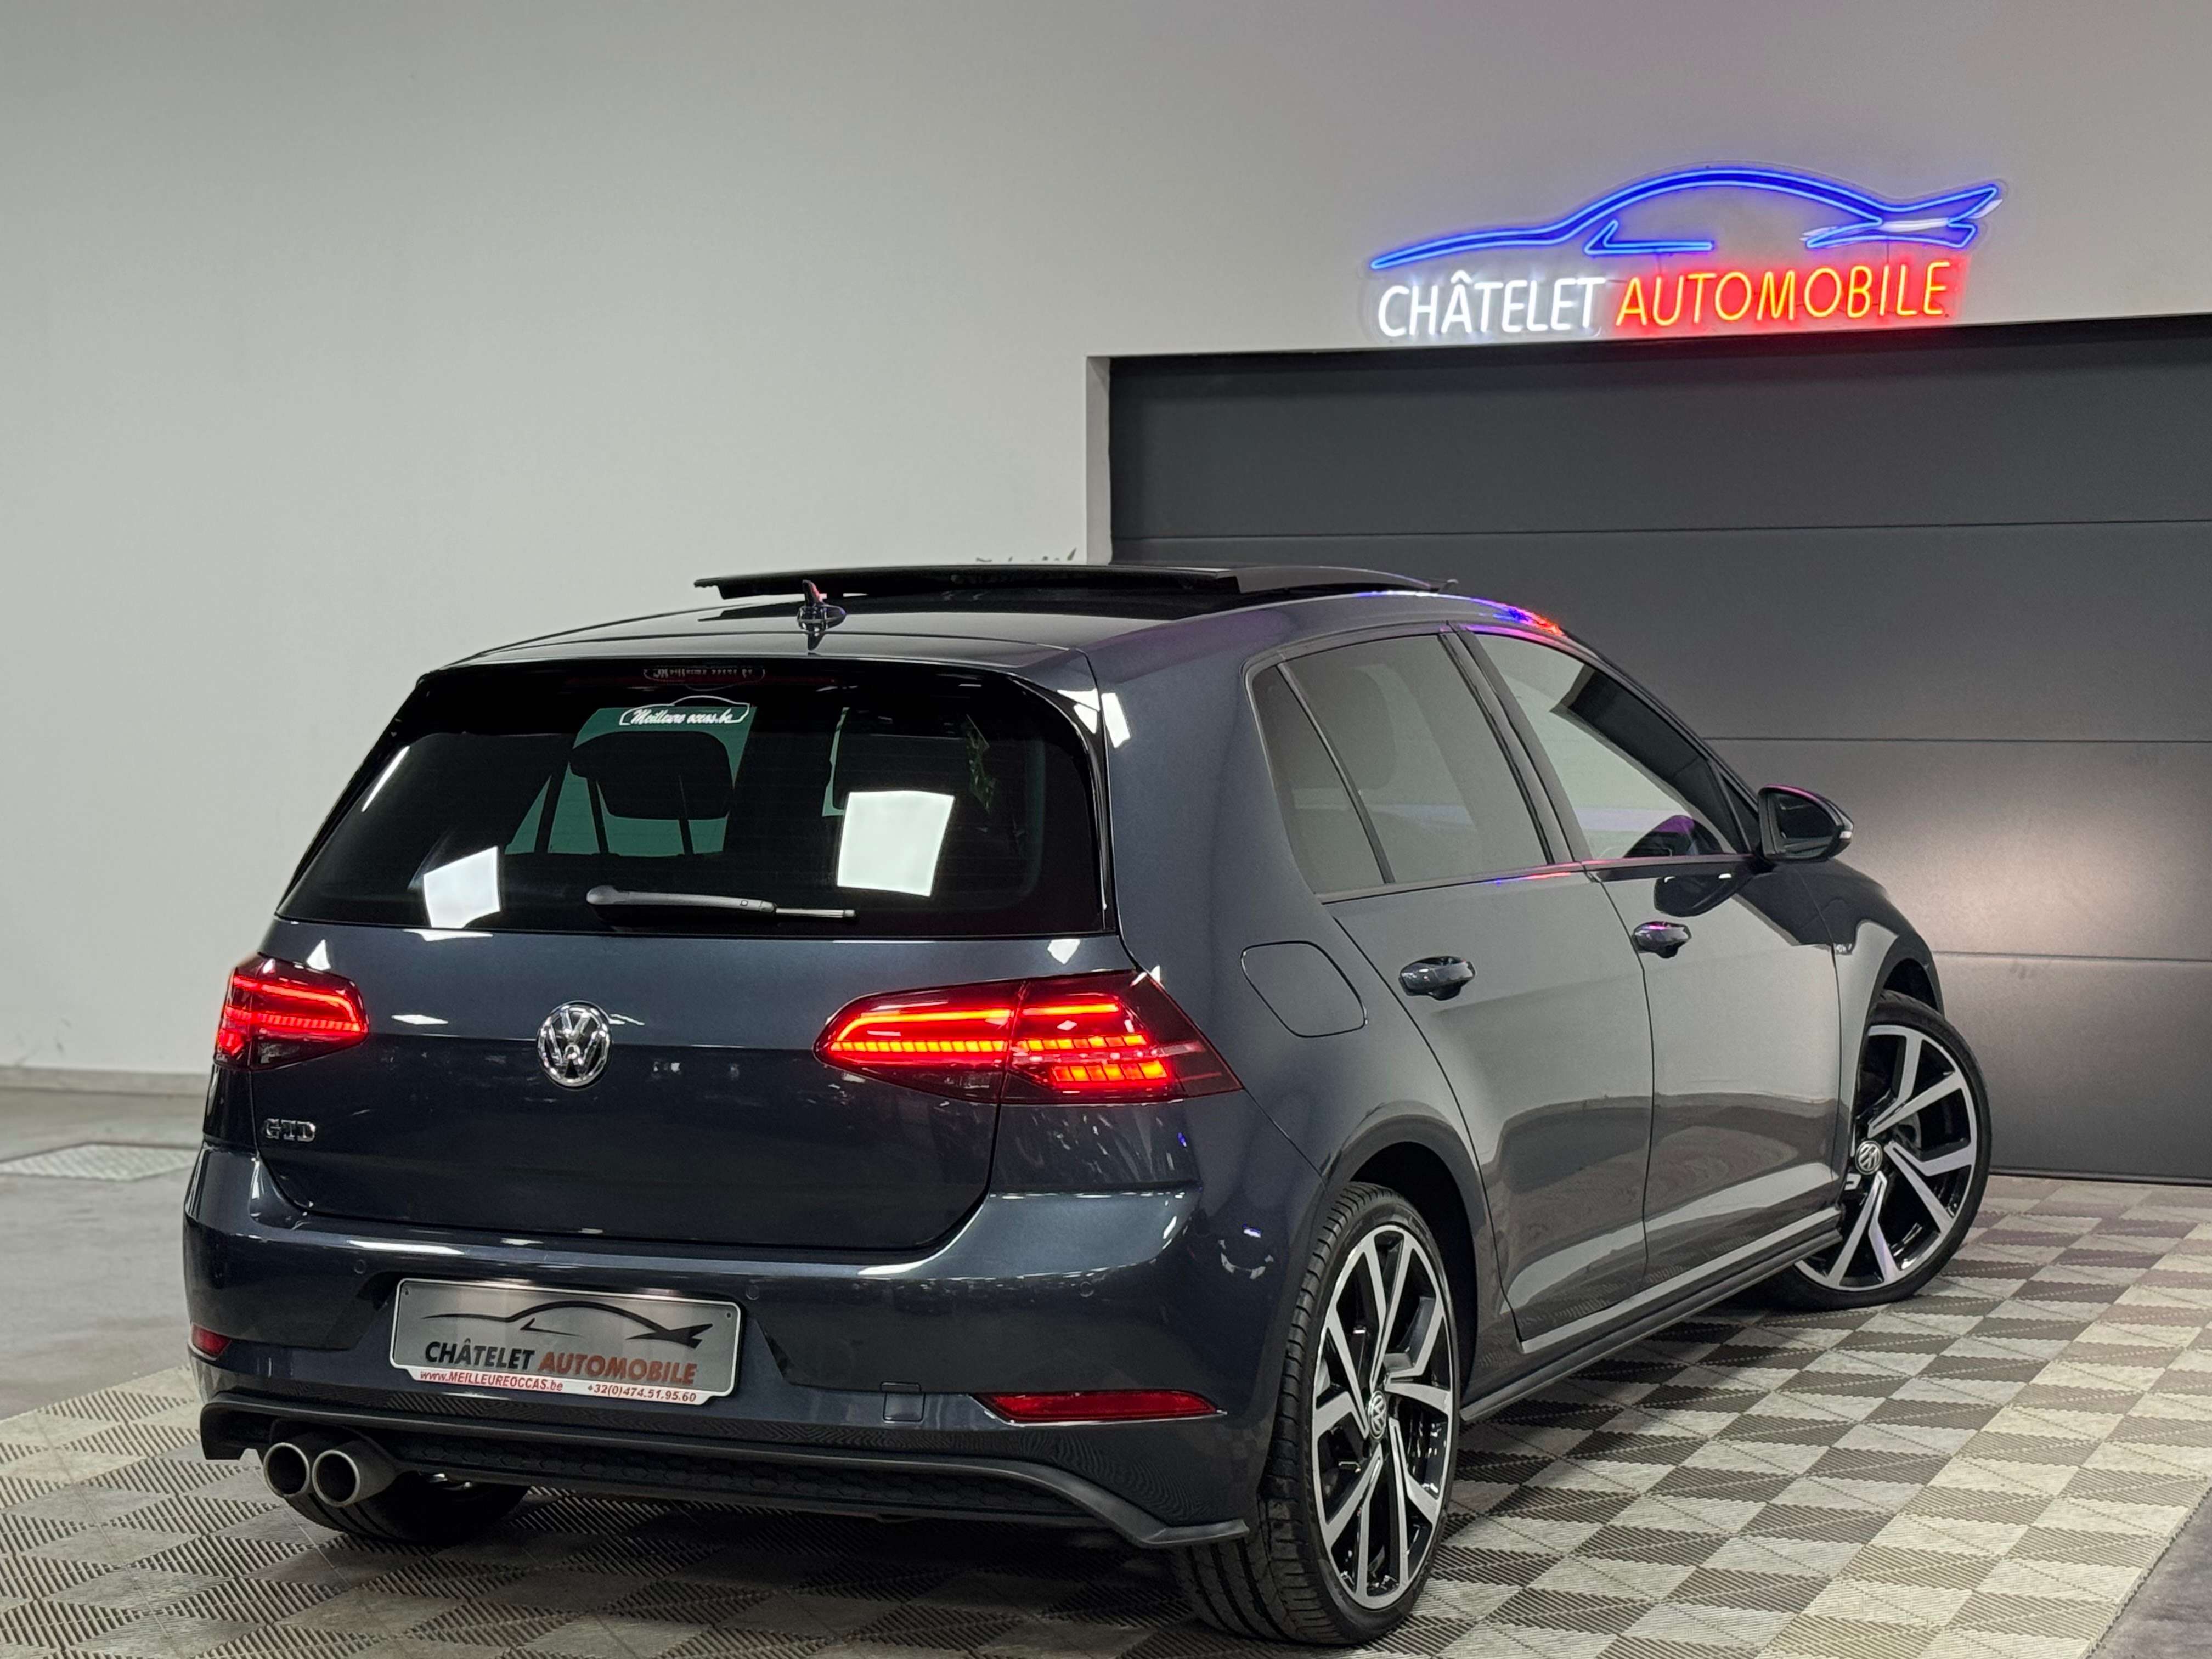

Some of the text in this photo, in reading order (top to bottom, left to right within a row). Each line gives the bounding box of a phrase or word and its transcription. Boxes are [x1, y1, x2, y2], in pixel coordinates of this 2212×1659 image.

[1378, 258, 1950, 337] CHÂTELET AUTOMOBILE
[265, 1118, 317, 1142] GTD
[425, 1338, 698, 1385] CHÂTELET AUTOMOBILE
[420, 1370, 697, 1403] www.MEILLEUREOCCAS.be +32(0)474.51.95.60
